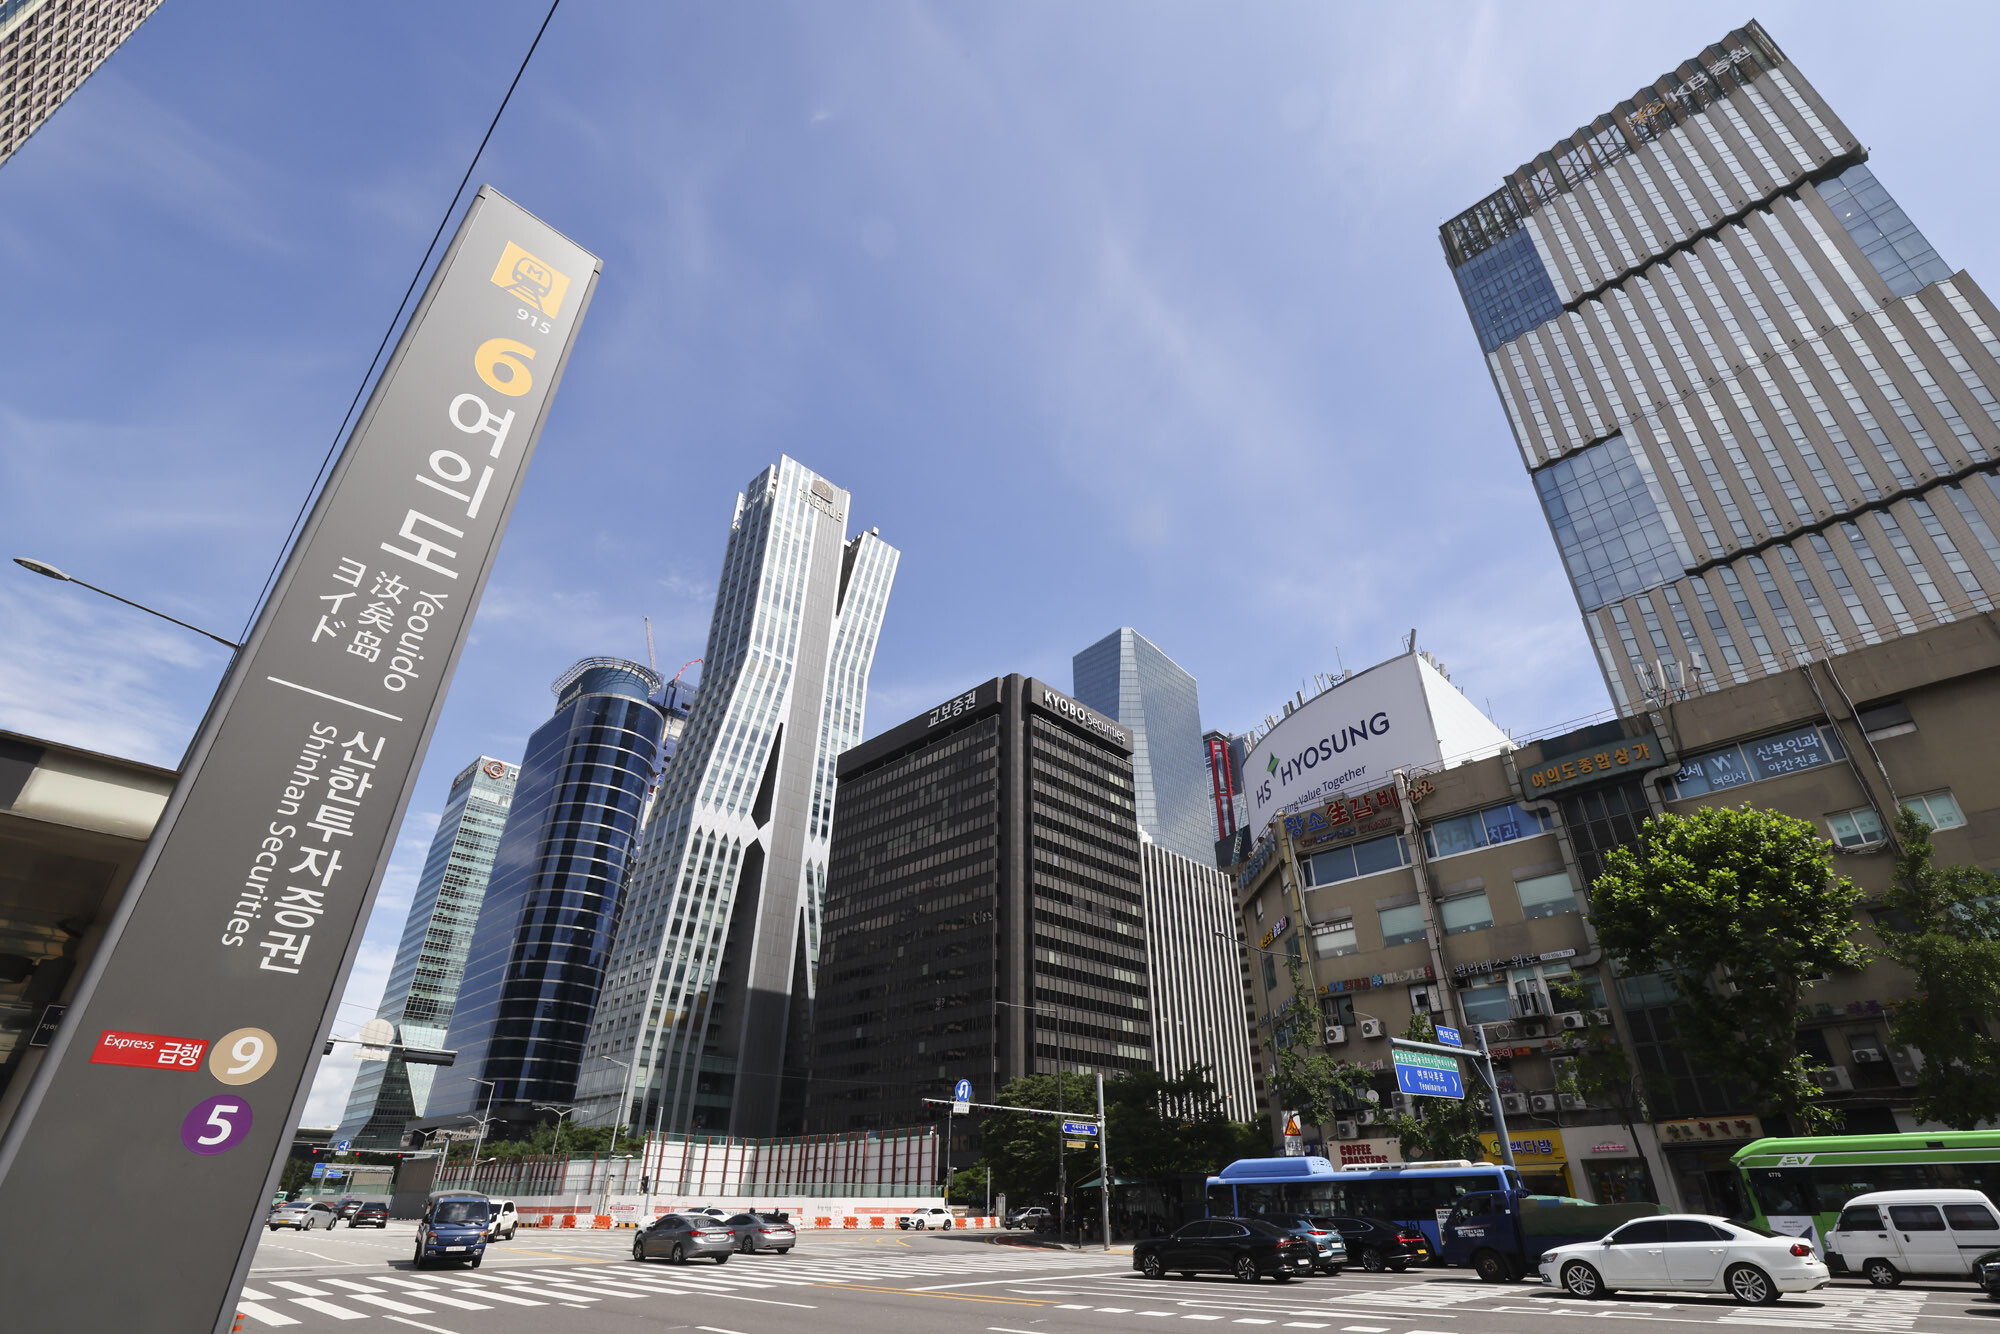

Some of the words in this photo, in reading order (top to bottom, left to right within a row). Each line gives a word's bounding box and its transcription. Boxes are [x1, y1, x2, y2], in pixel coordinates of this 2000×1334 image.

[516, 307, 551, 334] 915
[473, 337, 537, 397] 6
[380, 391, 516, 580] 여의도
[798, 488, 844, 523] TRENUE
[311, 556, 367, 643] ヨイド
[345, 570, 410, 663] 汝矣岛
[383, 590, 449, 692] Yeouido
[927, 689, 977, 729] 교보증권
[1044, 689, 1086, 721] KYOBO
[1087, 712, 1126, 743] Securities
[1256, 779, 1272, 809] HS
[1280, 711, 1390, 787] HYOSUNG
[1531, 742, 1650, 788] 여의도종합상가
[1756, 732, 1819, 761] 산부인과
[276, 721, 338, 816] Shinhan
[1298, 785, 1322, 806] Value
[1322, 764, 1367, 793] Together
[1712, 770, 1747, 787] 여의사
[1767, 753, 1822, 773] 야간진료
[259, 730, 386, 975] 신한투자증권
[1489, 823, 1519, 843] 치과
[221, 821, 297, 948] Securities
[1455, 958, 1507, 978] 필라테스
[1511, 953, 1540, 968] 위로
[104, 1034, 155, 1053] Express
[158, 1042, 203, 1067] 급행
[227, 1035, 265, 1075] 9
[1438, 1030, 1460, 1043] 여의도역
[1416, 1070, 1445, 1083] 여의나루로
[197, 1104, 239, 1145] 5
[1340, 1144, 1372, 1156] COFFEE
[1782, 1156, 1809, 1166] EV
